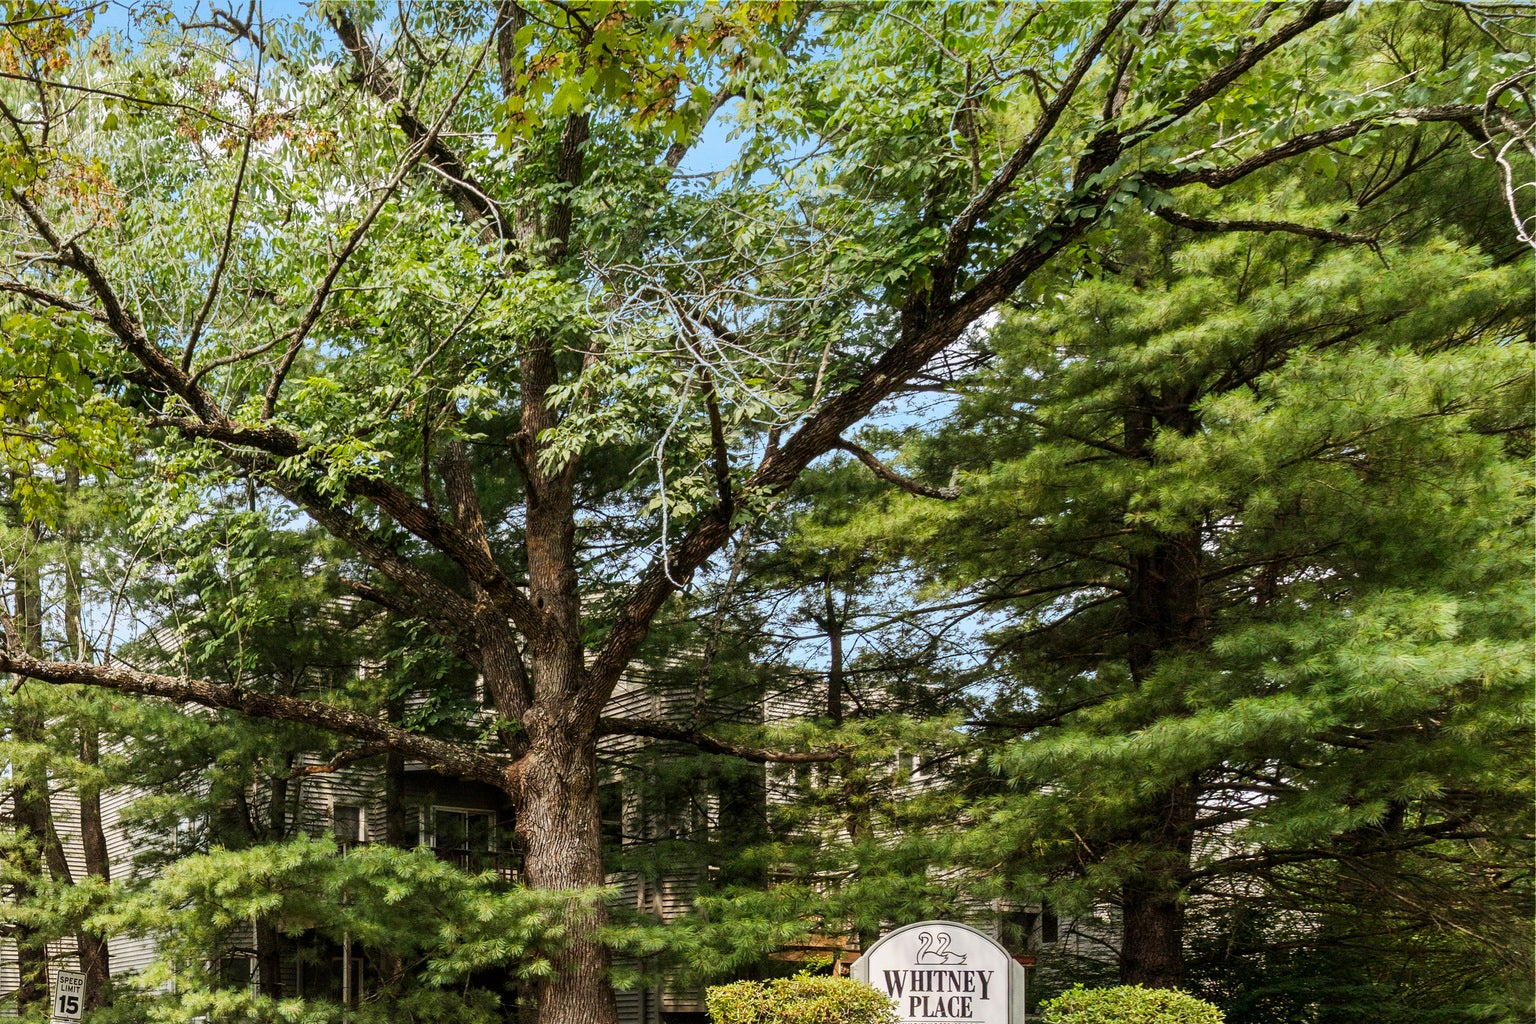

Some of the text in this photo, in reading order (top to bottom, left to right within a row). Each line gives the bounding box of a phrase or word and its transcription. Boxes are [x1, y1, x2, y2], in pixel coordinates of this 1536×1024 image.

[59, 976, 84, 986] SPEED
[61, 985, 80, 993] LIMIT
[882, 969, 995, 1001] WHITNEY
[59, 995, 79, 1014] 15
[908, 995, 974, 1019] PLACE
